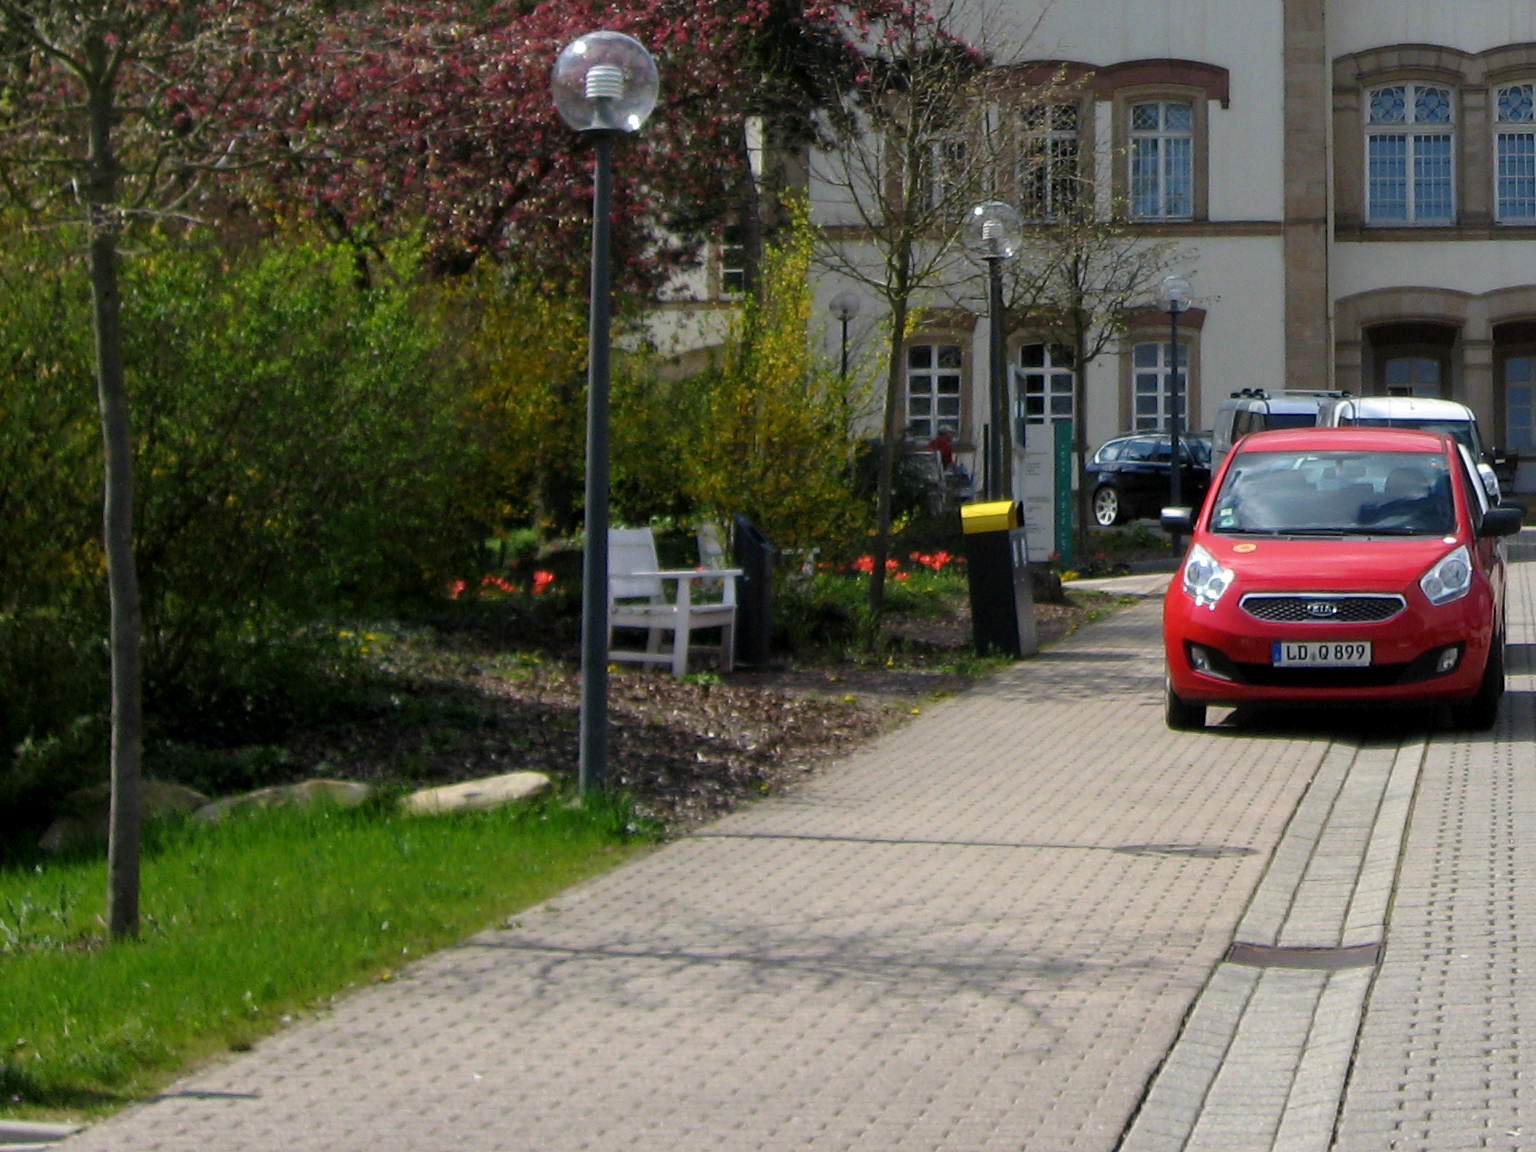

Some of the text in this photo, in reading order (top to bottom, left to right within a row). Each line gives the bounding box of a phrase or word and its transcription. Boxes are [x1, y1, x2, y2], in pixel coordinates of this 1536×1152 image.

[1287, 645, 1365, 660] LD Q 899
